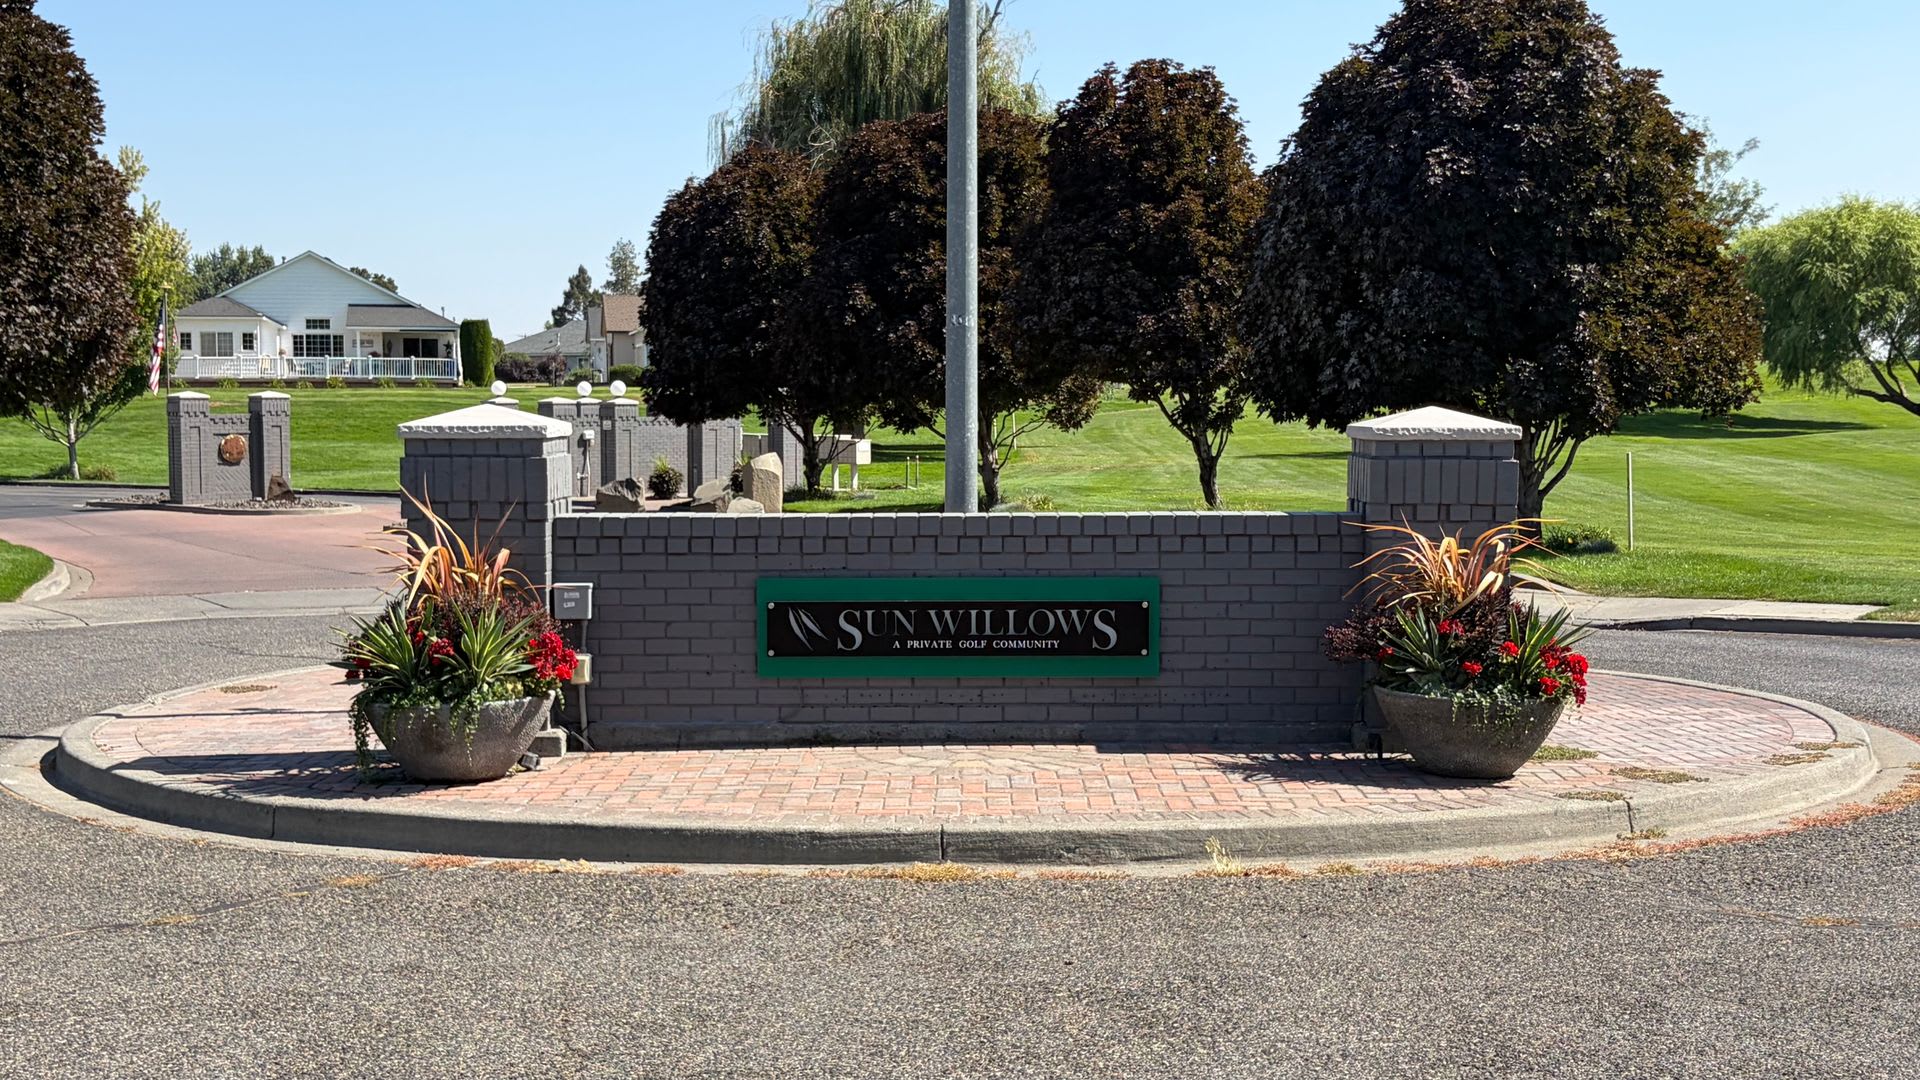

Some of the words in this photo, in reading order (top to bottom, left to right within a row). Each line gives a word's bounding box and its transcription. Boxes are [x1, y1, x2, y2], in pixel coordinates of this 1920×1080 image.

[837, 609, 916, 651] SUN
[927, 608, 1118, 651] WILLOWS
[892, 640, 901, 649] A
[907, 640, 953, 649] PRIVATE
[958, 640, 987, 649] GOLF
[992, 640, 1060, 649] COMMUNITY
